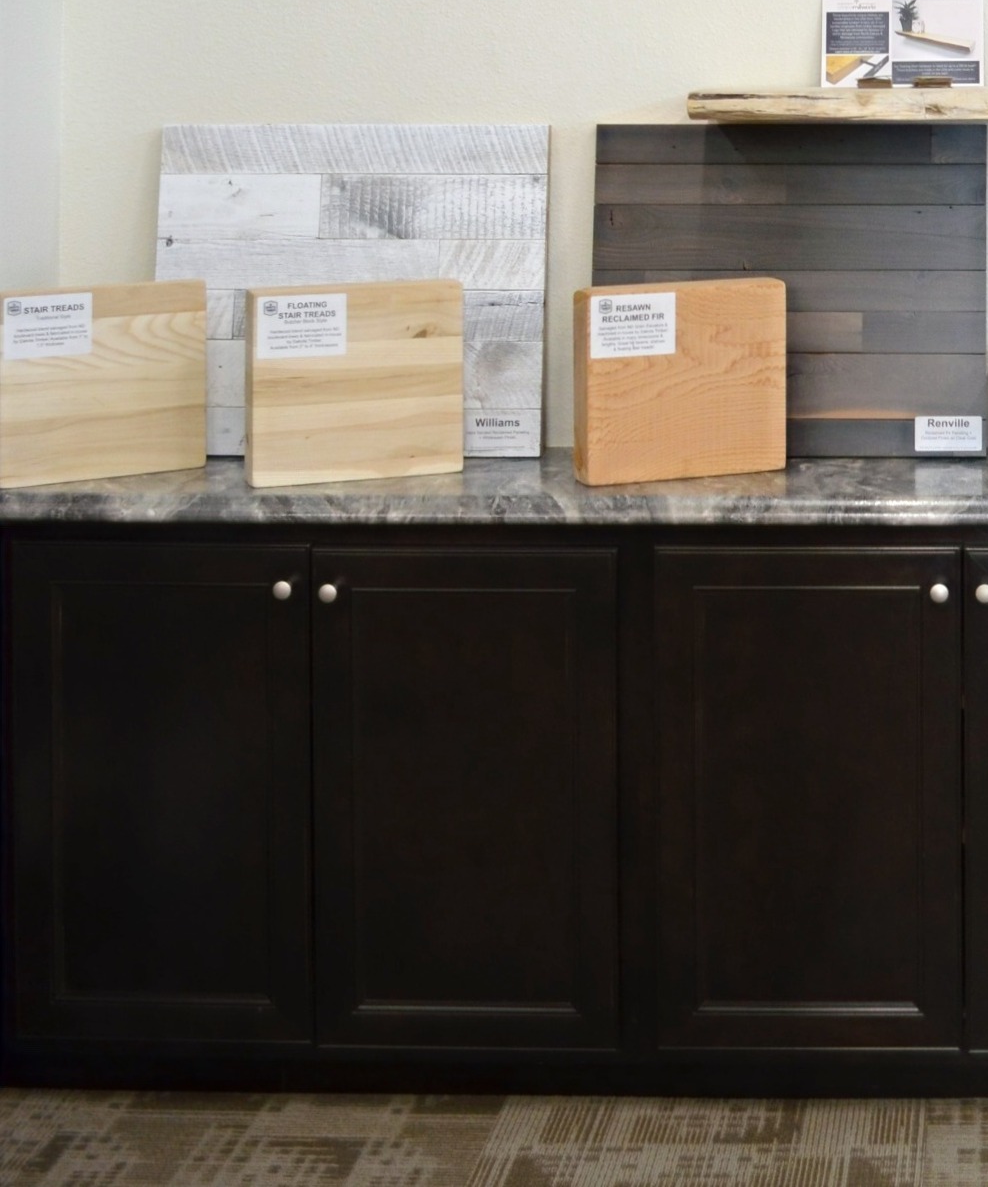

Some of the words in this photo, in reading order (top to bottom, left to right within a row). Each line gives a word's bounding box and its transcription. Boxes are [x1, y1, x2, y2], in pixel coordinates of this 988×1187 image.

[24, 305, 49, 315] STAIR
[50, 303, 85, 313] TREADS
[287, 301, 328, 310] FLOATING
[616, 303, 651, 312] RESAWN
[278, 311, 302, 320] STAIR
[304, 310, 336, 318] TREADS
[602, 314, 650, 323] RECLAIMED
[651, 312, 665, 320] FIR
[474, 417, 521, 428] Williams
[927, 418, 971, 429] Renville
